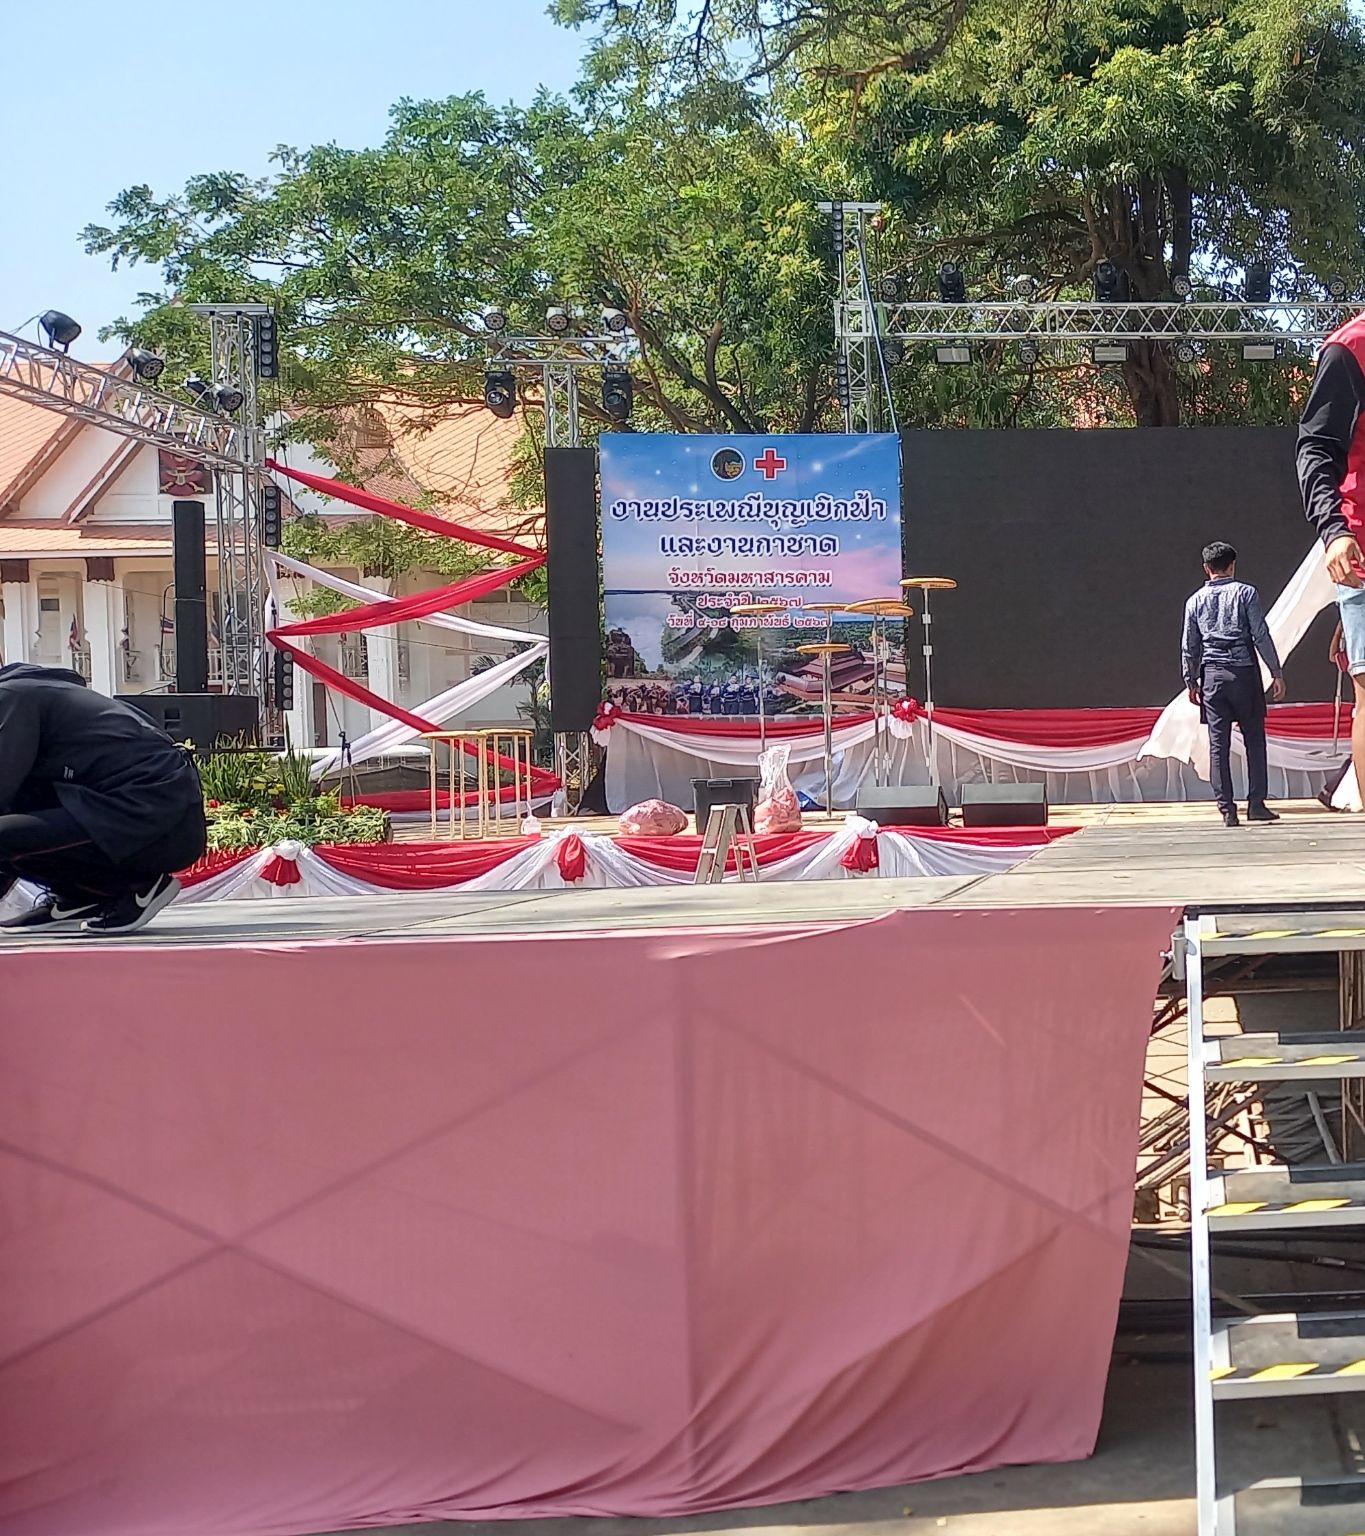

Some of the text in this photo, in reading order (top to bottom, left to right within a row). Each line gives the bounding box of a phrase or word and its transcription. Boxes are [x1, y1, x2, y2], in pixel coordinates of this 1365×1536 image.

[611, 493, 885, 528] งานประเพณีบุญเบิกฟ้า
[660, 534, 838, 554] และงานกาชาด
[668, 567, 832, 585] จังหวัดมหาสารคาม
[697, 593, 752, 607] ประจำปี
[667, 611, 693, 627] วันที่
[731, 615, 790, 632] กุมภาพันธ์
